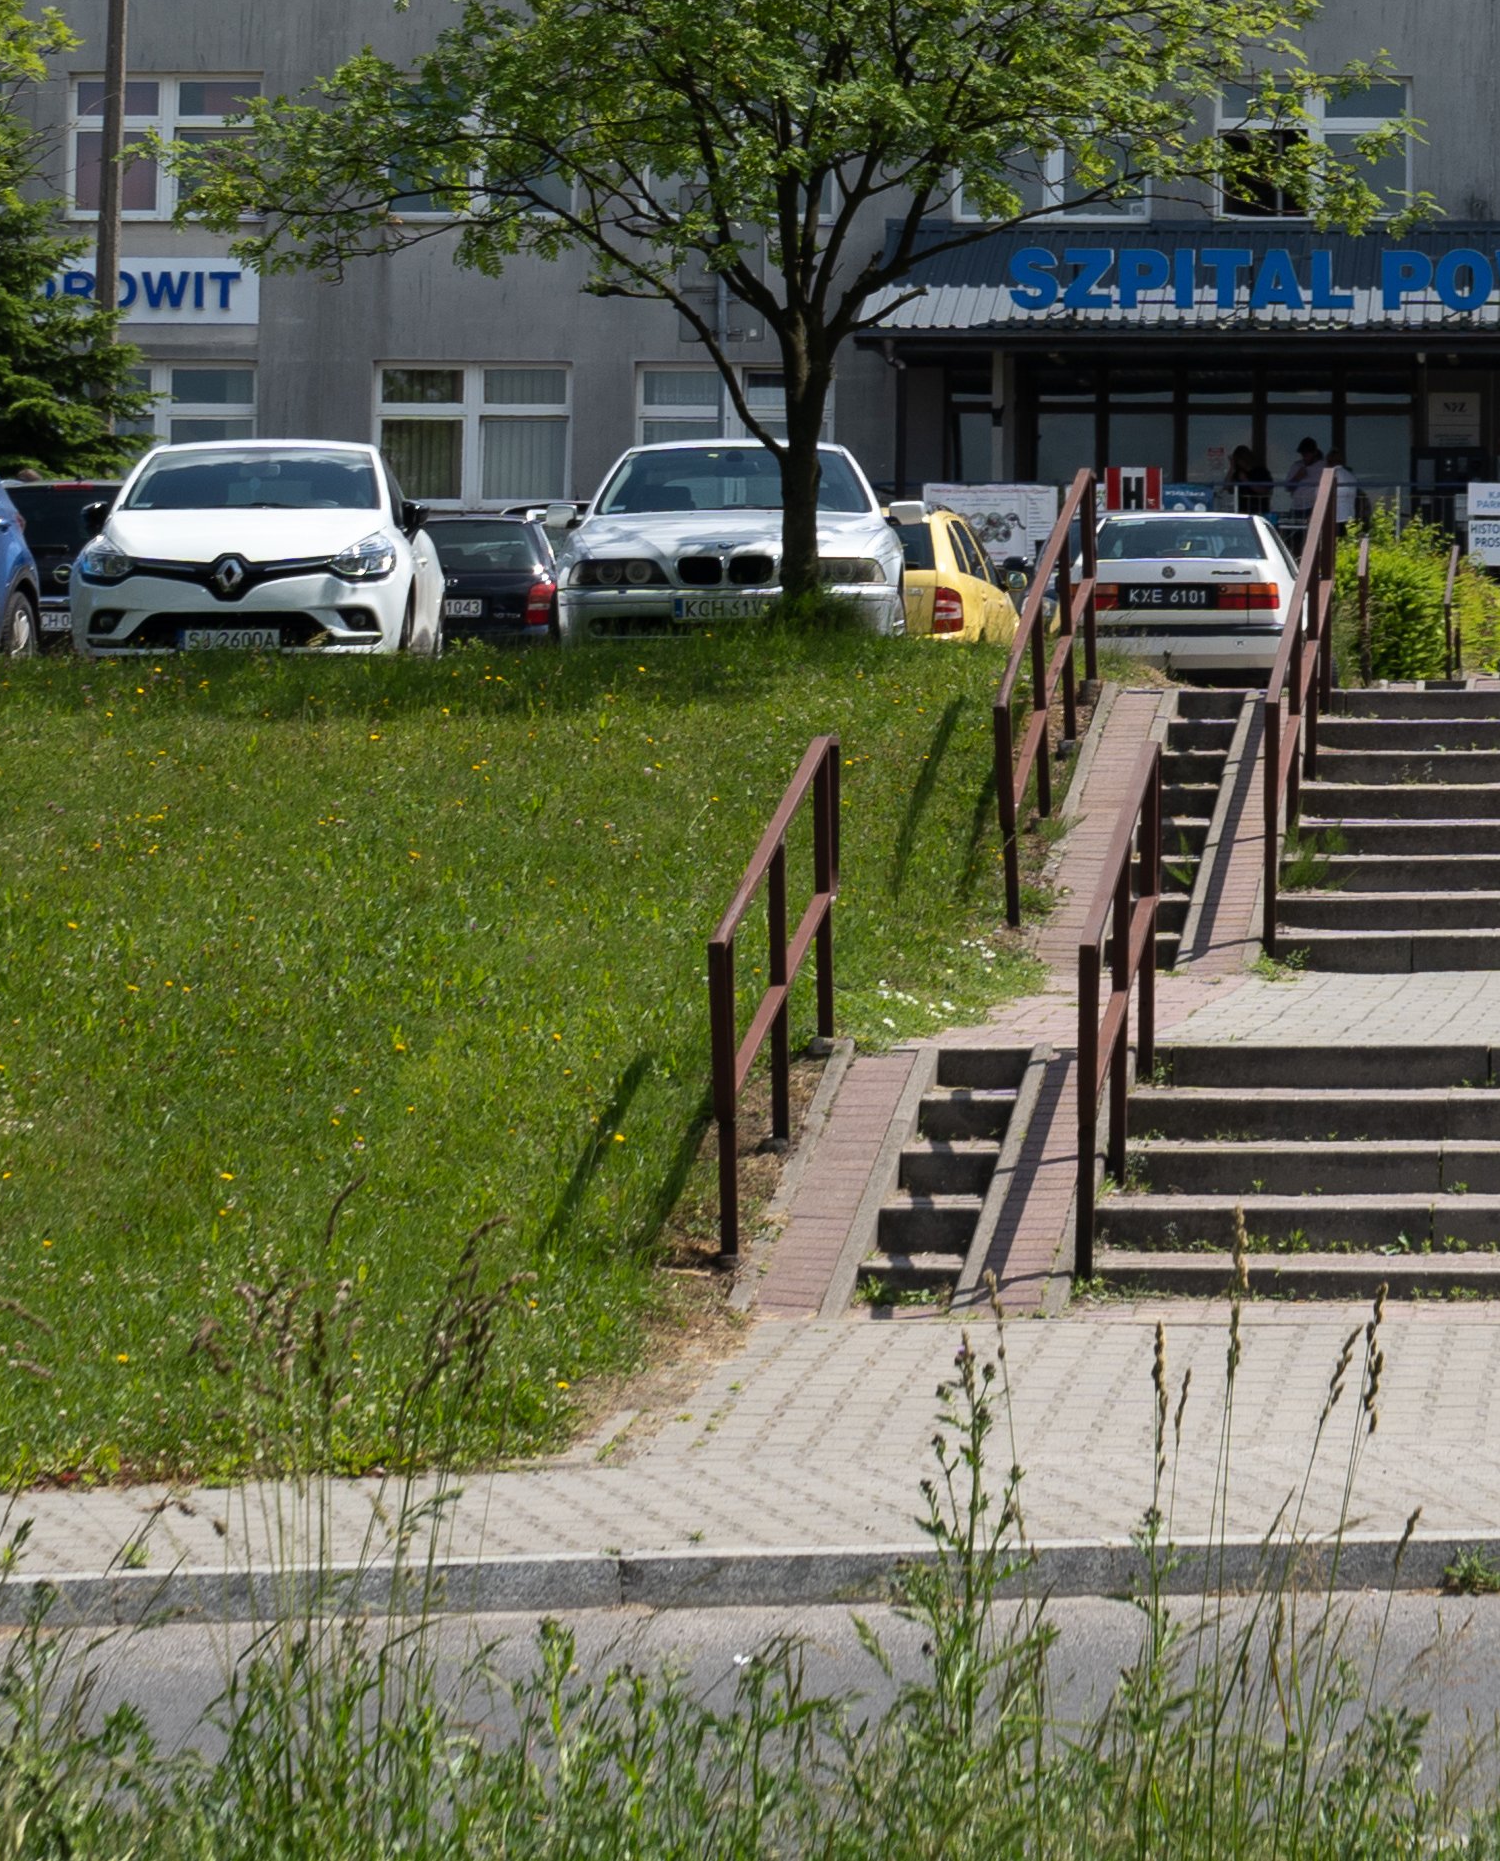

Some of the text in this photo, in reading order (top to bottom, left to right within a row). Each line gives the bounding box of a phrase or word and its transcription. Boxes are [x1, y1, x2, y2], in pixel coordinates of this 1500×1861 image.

[1008, 247, 1355, 311] SZPITAL
[1169, 590, 1206, 604] 6101
[446, 601, 480, 614] 1043
[685, 600, 725, 617] KCH
[219, 631, 278, 649] 2600A
